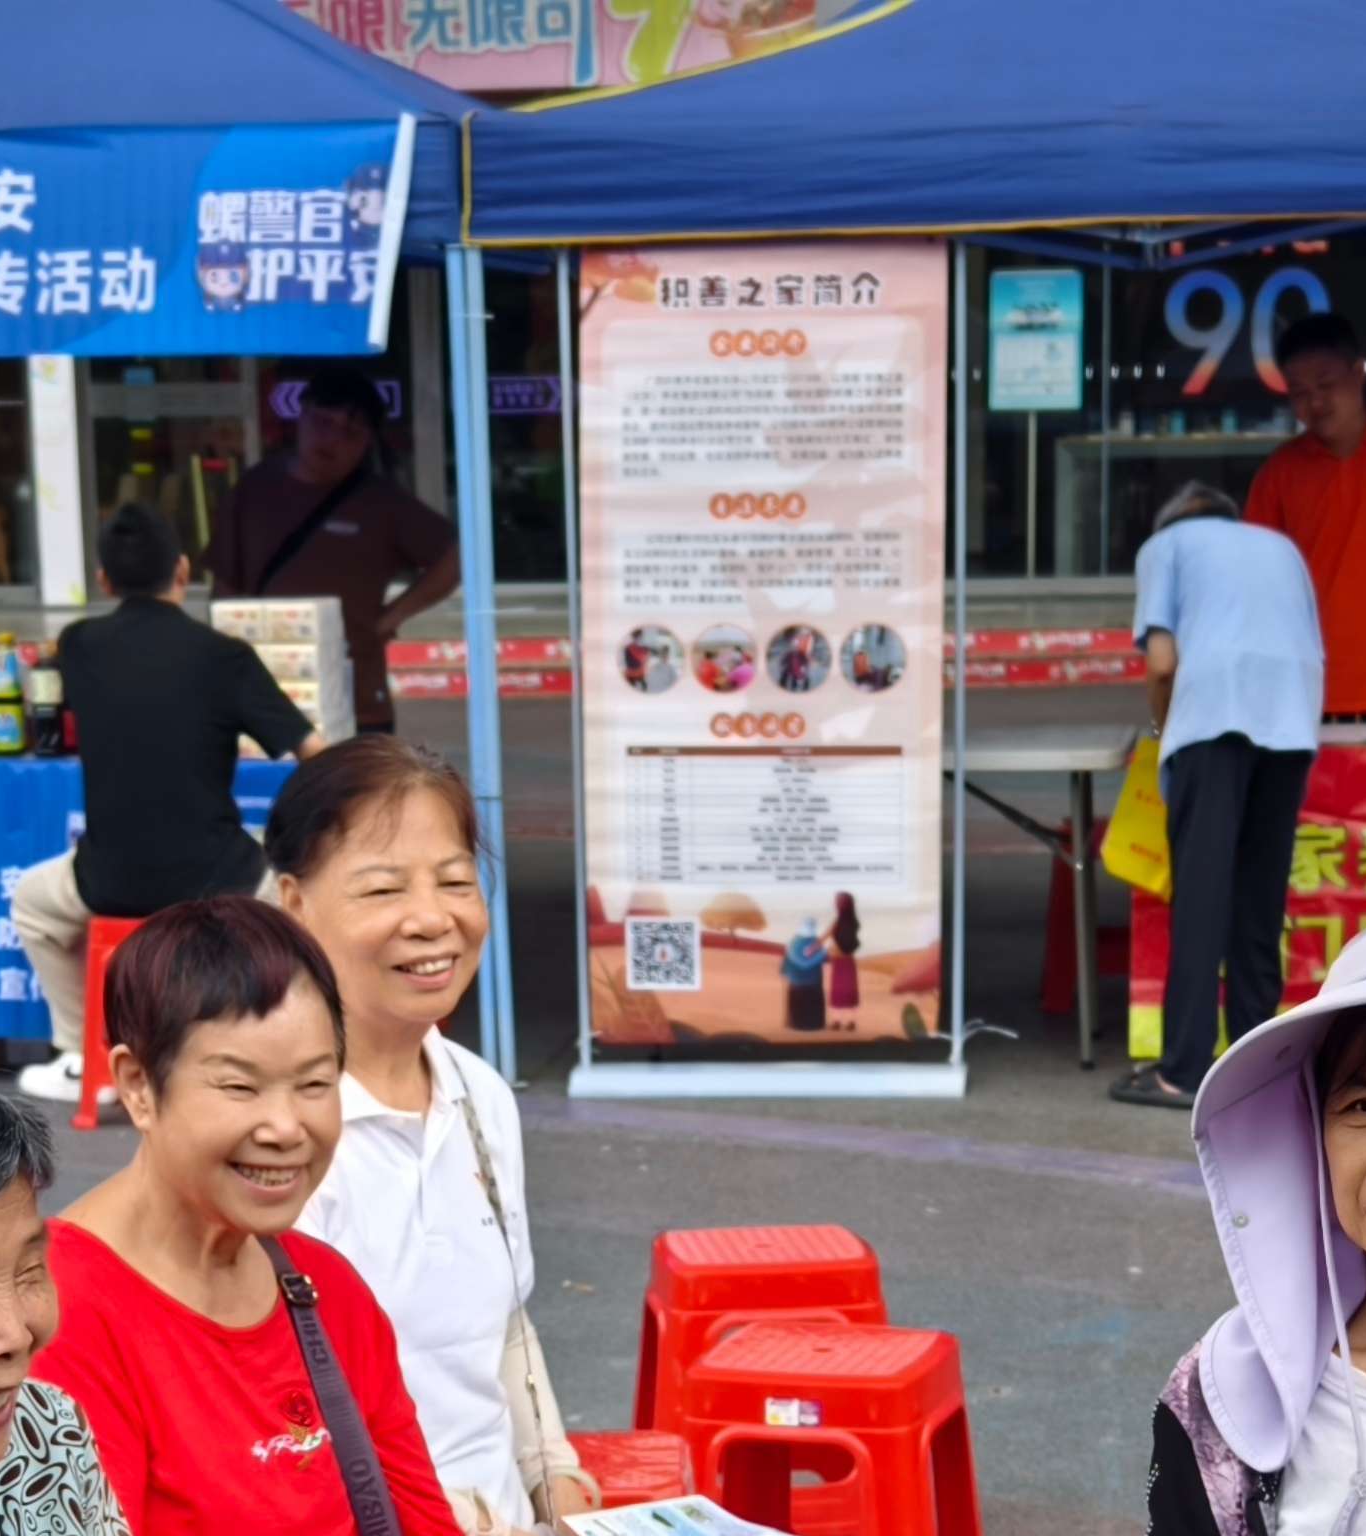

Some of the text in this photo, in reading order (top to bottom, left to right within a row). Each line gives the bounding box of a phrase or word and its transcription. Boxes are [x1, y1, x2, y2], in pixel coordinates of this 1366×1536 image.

[198, 189, 348, 244] 螺警官
[659, 272, 881, 308] 积善之家简介
